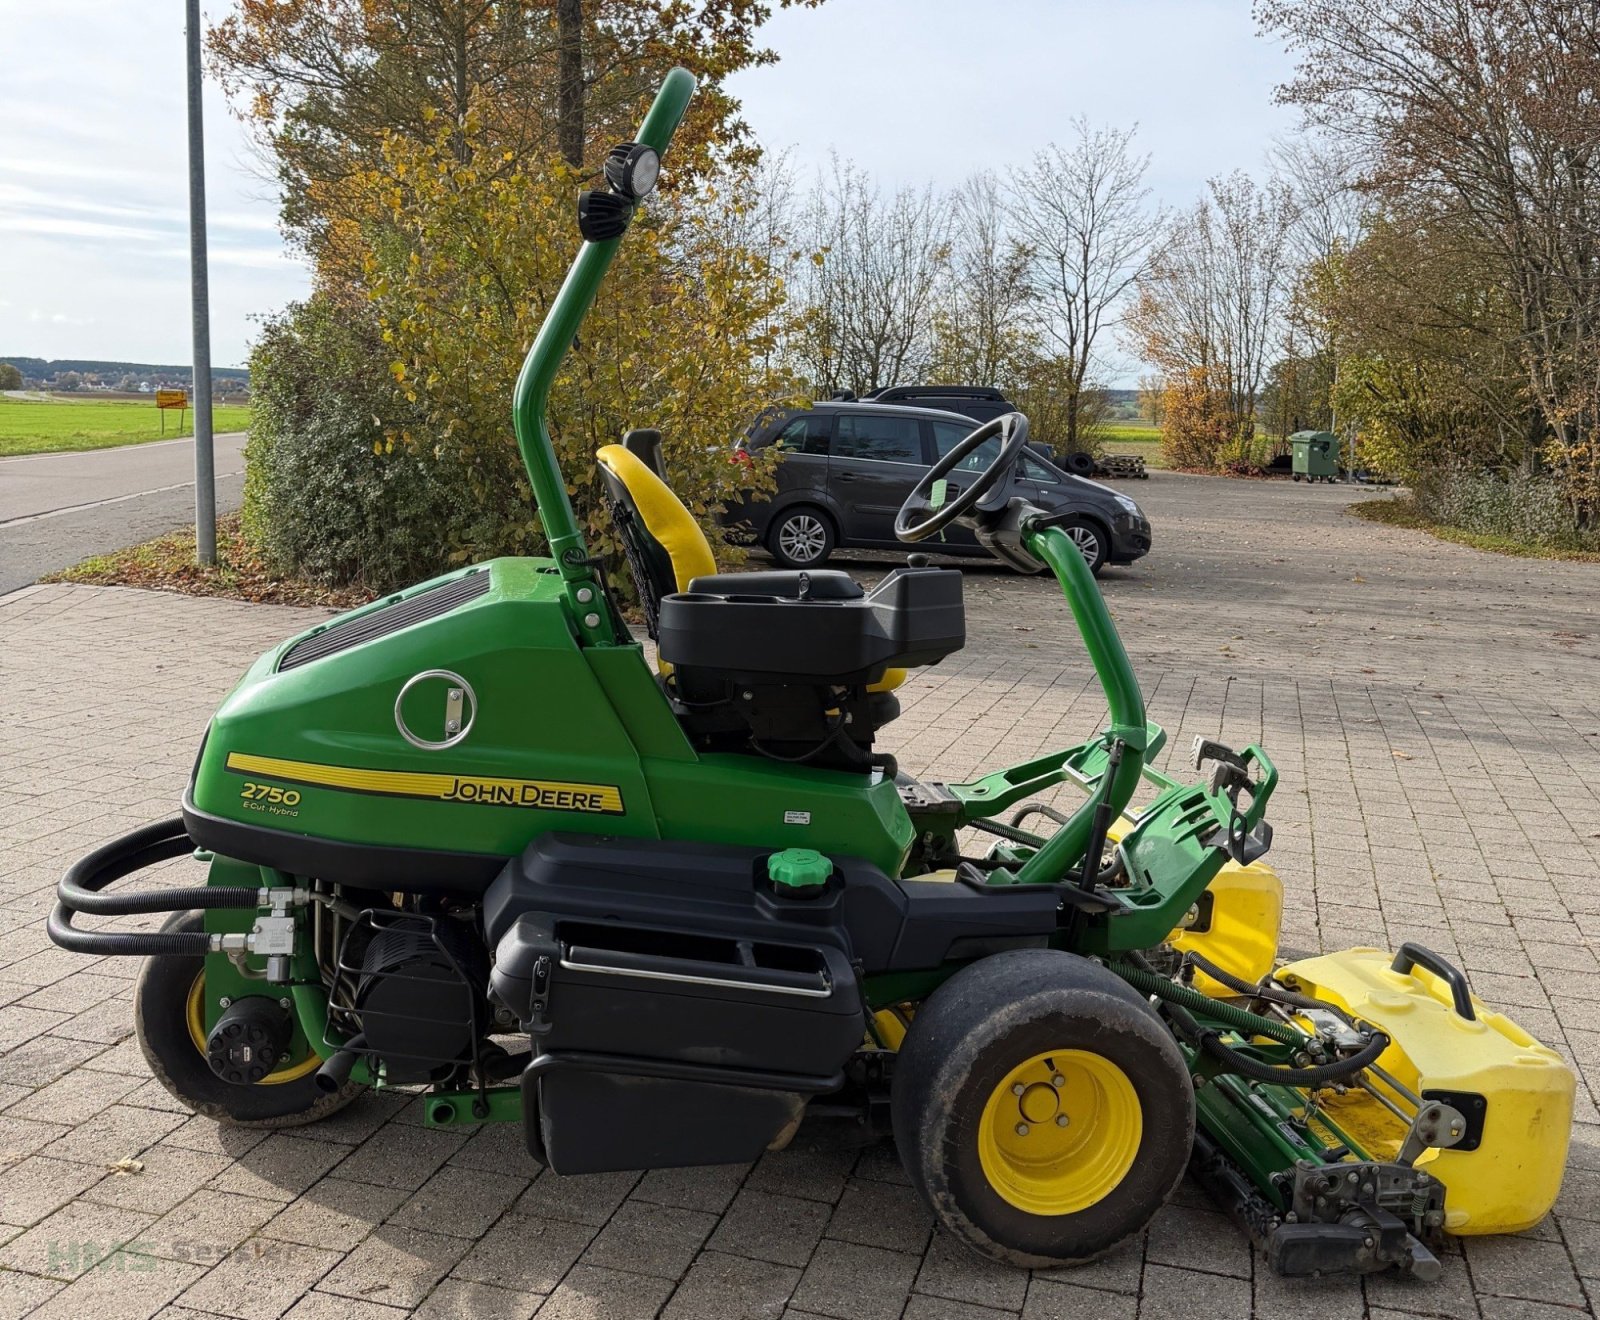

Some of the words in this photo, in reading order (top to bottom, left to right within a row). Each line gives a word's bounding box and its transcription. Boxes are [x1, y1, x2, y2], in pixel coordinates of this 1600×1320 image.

[240, 782, 301, 806] 2750
[443, 779, 514, 803] JOHN
[520, 784, 604, 809] DEERE
[269, 805, 299, 817] Hybrid
